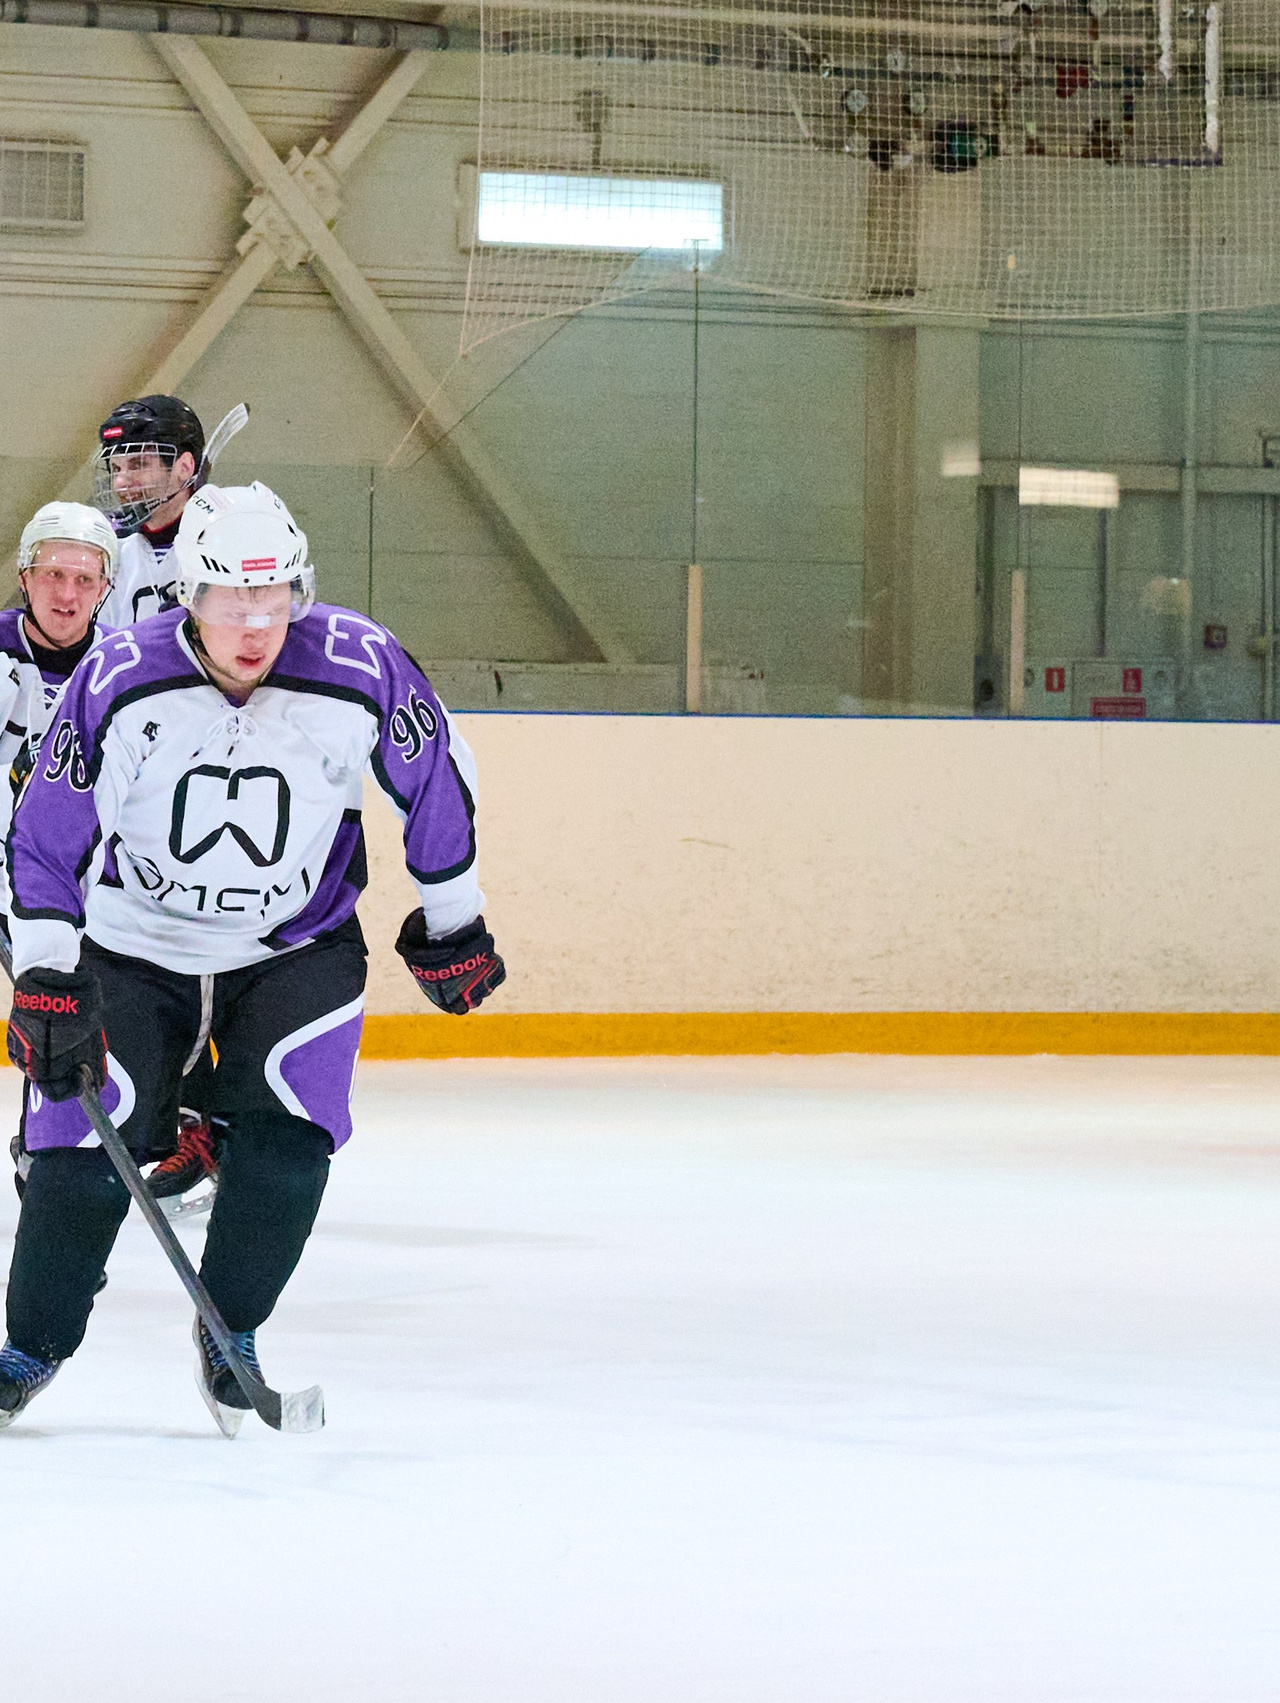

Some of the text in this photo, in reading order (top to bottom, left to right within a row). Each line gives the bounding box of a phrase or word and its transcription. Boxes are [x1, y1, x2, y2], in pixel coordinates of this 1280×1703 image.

[389, 683, 438, 764] 96
[43, 719, 94, 793] 96
[410, 951, 488, 981] Reebok
[14, 990, 79, 1015] Reebok
